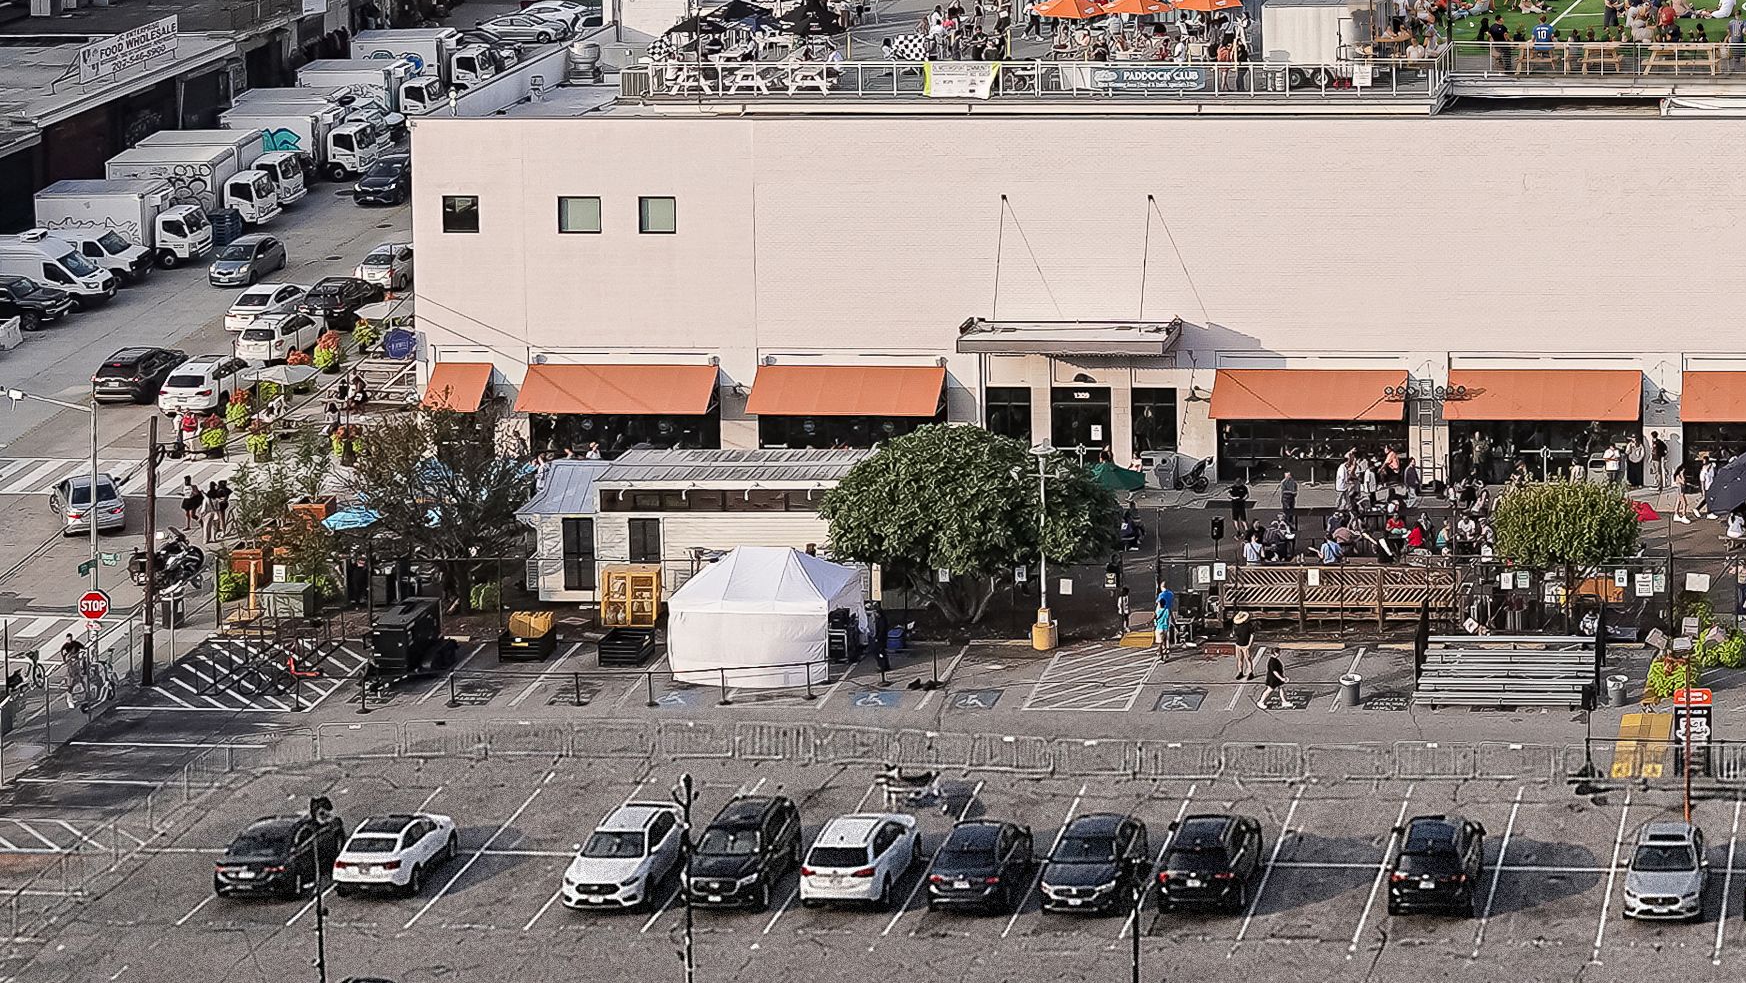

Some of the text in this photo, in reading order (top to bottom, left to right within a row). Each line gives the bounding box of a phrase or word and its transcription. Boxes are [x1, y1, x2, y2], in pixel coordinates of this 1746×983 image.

[1537, 30, 1547, 39] 10
[100, 43, 124, 59] FOOD
[126, 23, 176, 49] WHOLESALE
[1123, 71, 1171, 81] PADDOCK
[1173, 71, 1199, 81] CLUB
[80, 600, 107, 612] STOP
